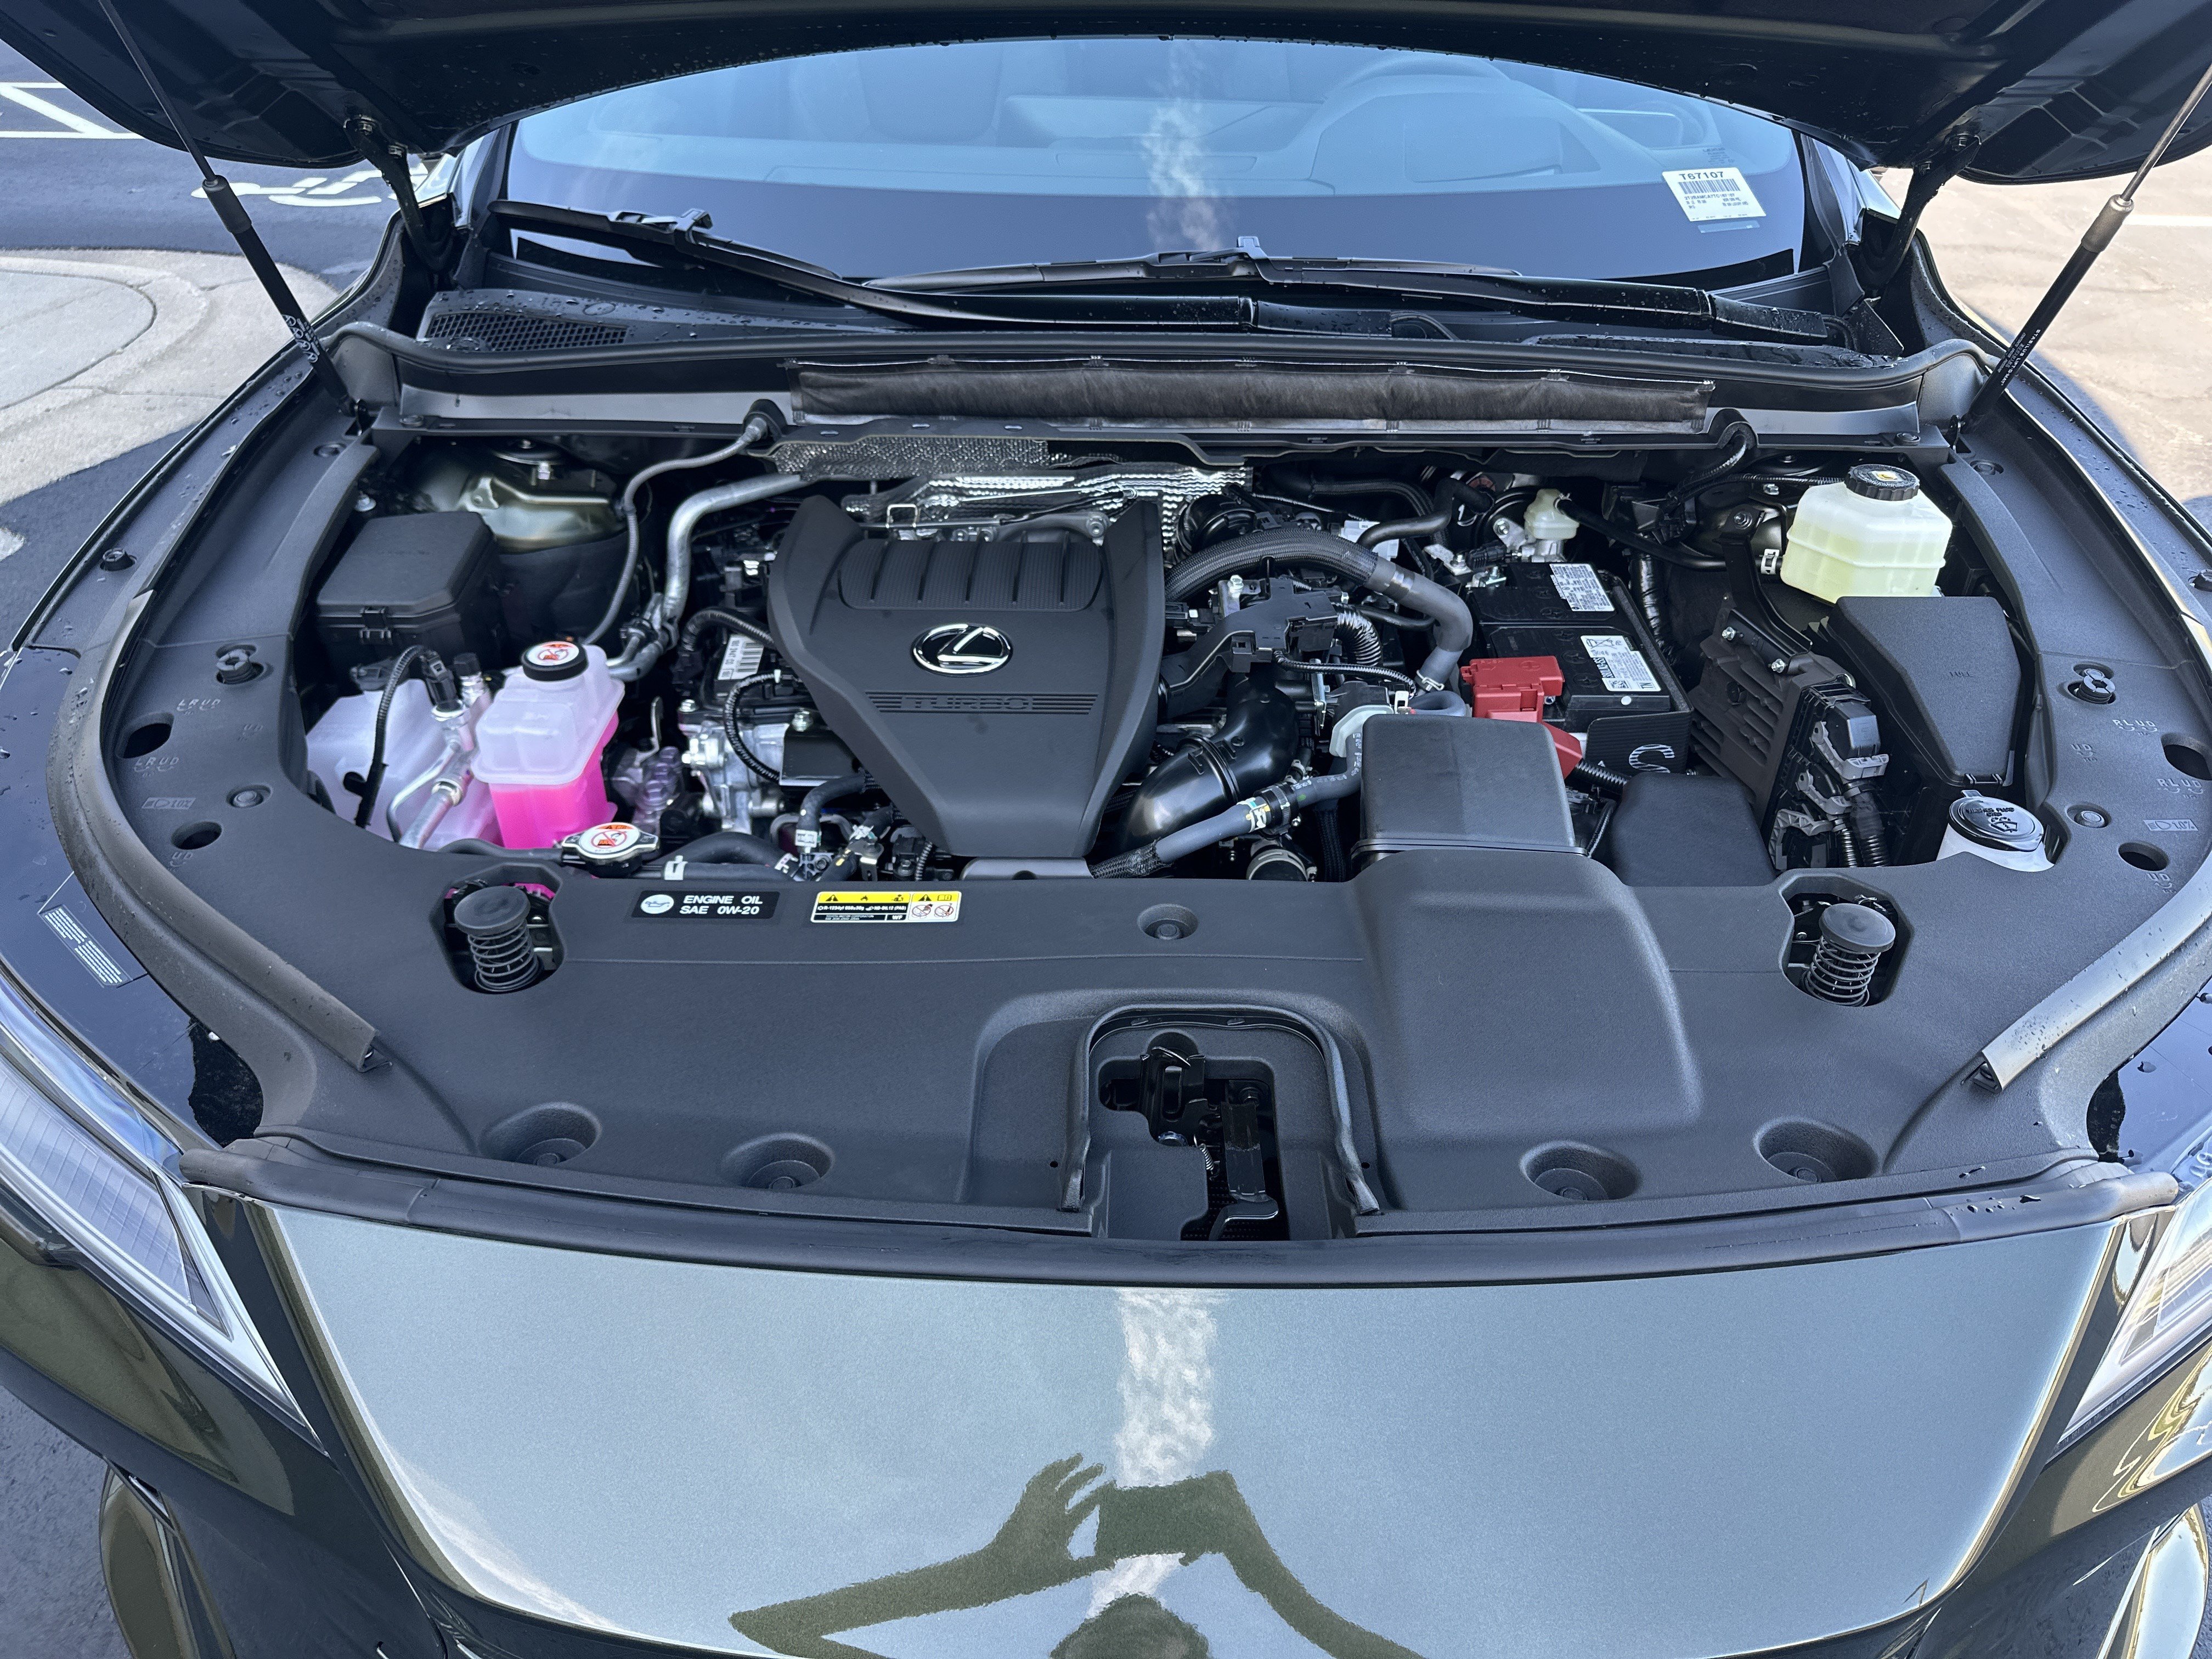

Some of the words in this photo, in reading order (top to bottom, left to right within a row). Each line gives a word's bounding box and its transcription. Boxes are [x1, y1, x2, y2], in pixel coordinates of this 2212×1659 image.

[1679, 172, 1723, 180] T67107
[905, 697, 1029, 710] TURBO
[683, 895, 734, 904] ENGINE
[741, 895, 763, 904] OIL
[679, 906, 709, 915] SAE
[717, 906, 760, 915] 0W-20
